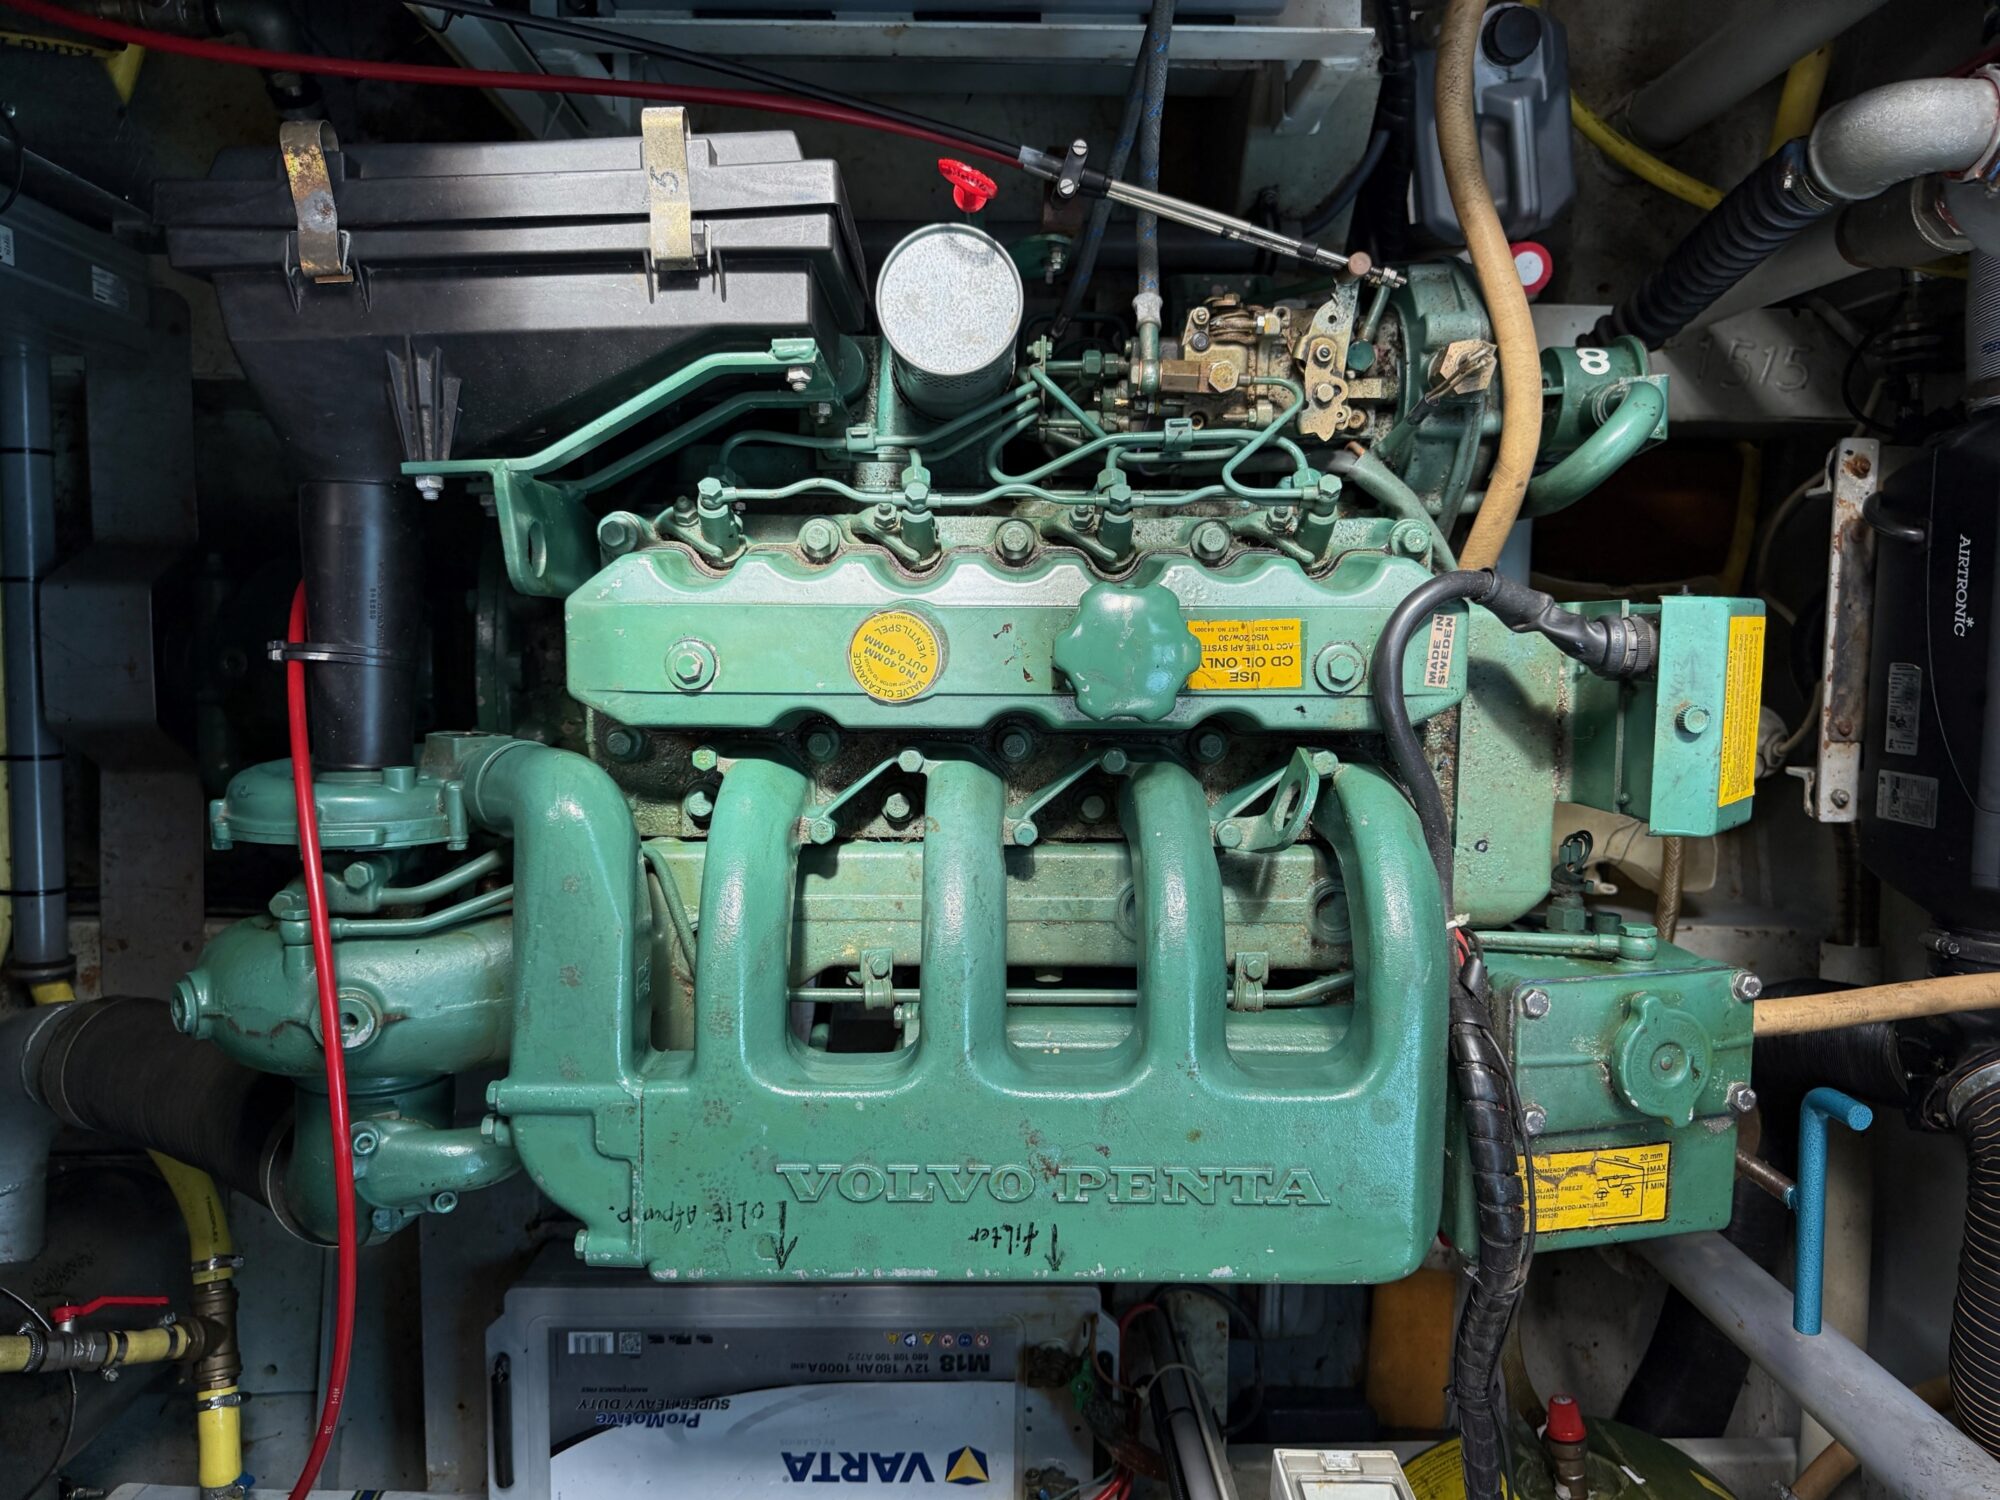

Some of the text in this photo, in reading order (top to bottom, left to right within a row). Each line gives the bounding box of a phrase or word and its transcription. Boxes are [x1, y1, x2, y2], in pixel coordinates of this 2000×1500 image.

[1576, 347, 1611, 376] 8
[1954, 533, 1974, 637] AIRTRONIC
[874, 624, 927, 660] VENTILSPEL
[1230, 644, 1244, 652] API
[1246, 644, 1260, 652] THE
[1262, 643, 1274, 651] TO
[1276, 642, 1294, 650] ACC
[1428, 616, 1444, 683] MADE IN
[1437, 617, 1453, 684] SWEDEN
[905, 658, 928, 673] OUT
[1242, 656, 1266, 668] OIL
[1271, 655, 1294, 667] CD
[853, 652, 926, 698] VALVE CLEARANCE
[1229, 671, 1261, 683] USE
[775, 1163, 1330, 1206] VOLVO PENTA
[875, 1353, 891, 1361] 100
[939, 1353, 991, 1372] M18
[576, 1398, 731, 1411] SUPER HEAVY DUTY
[595, 1412, 701, 1429] ProMotive
[781, 1452, 935, 1483] VARTA
